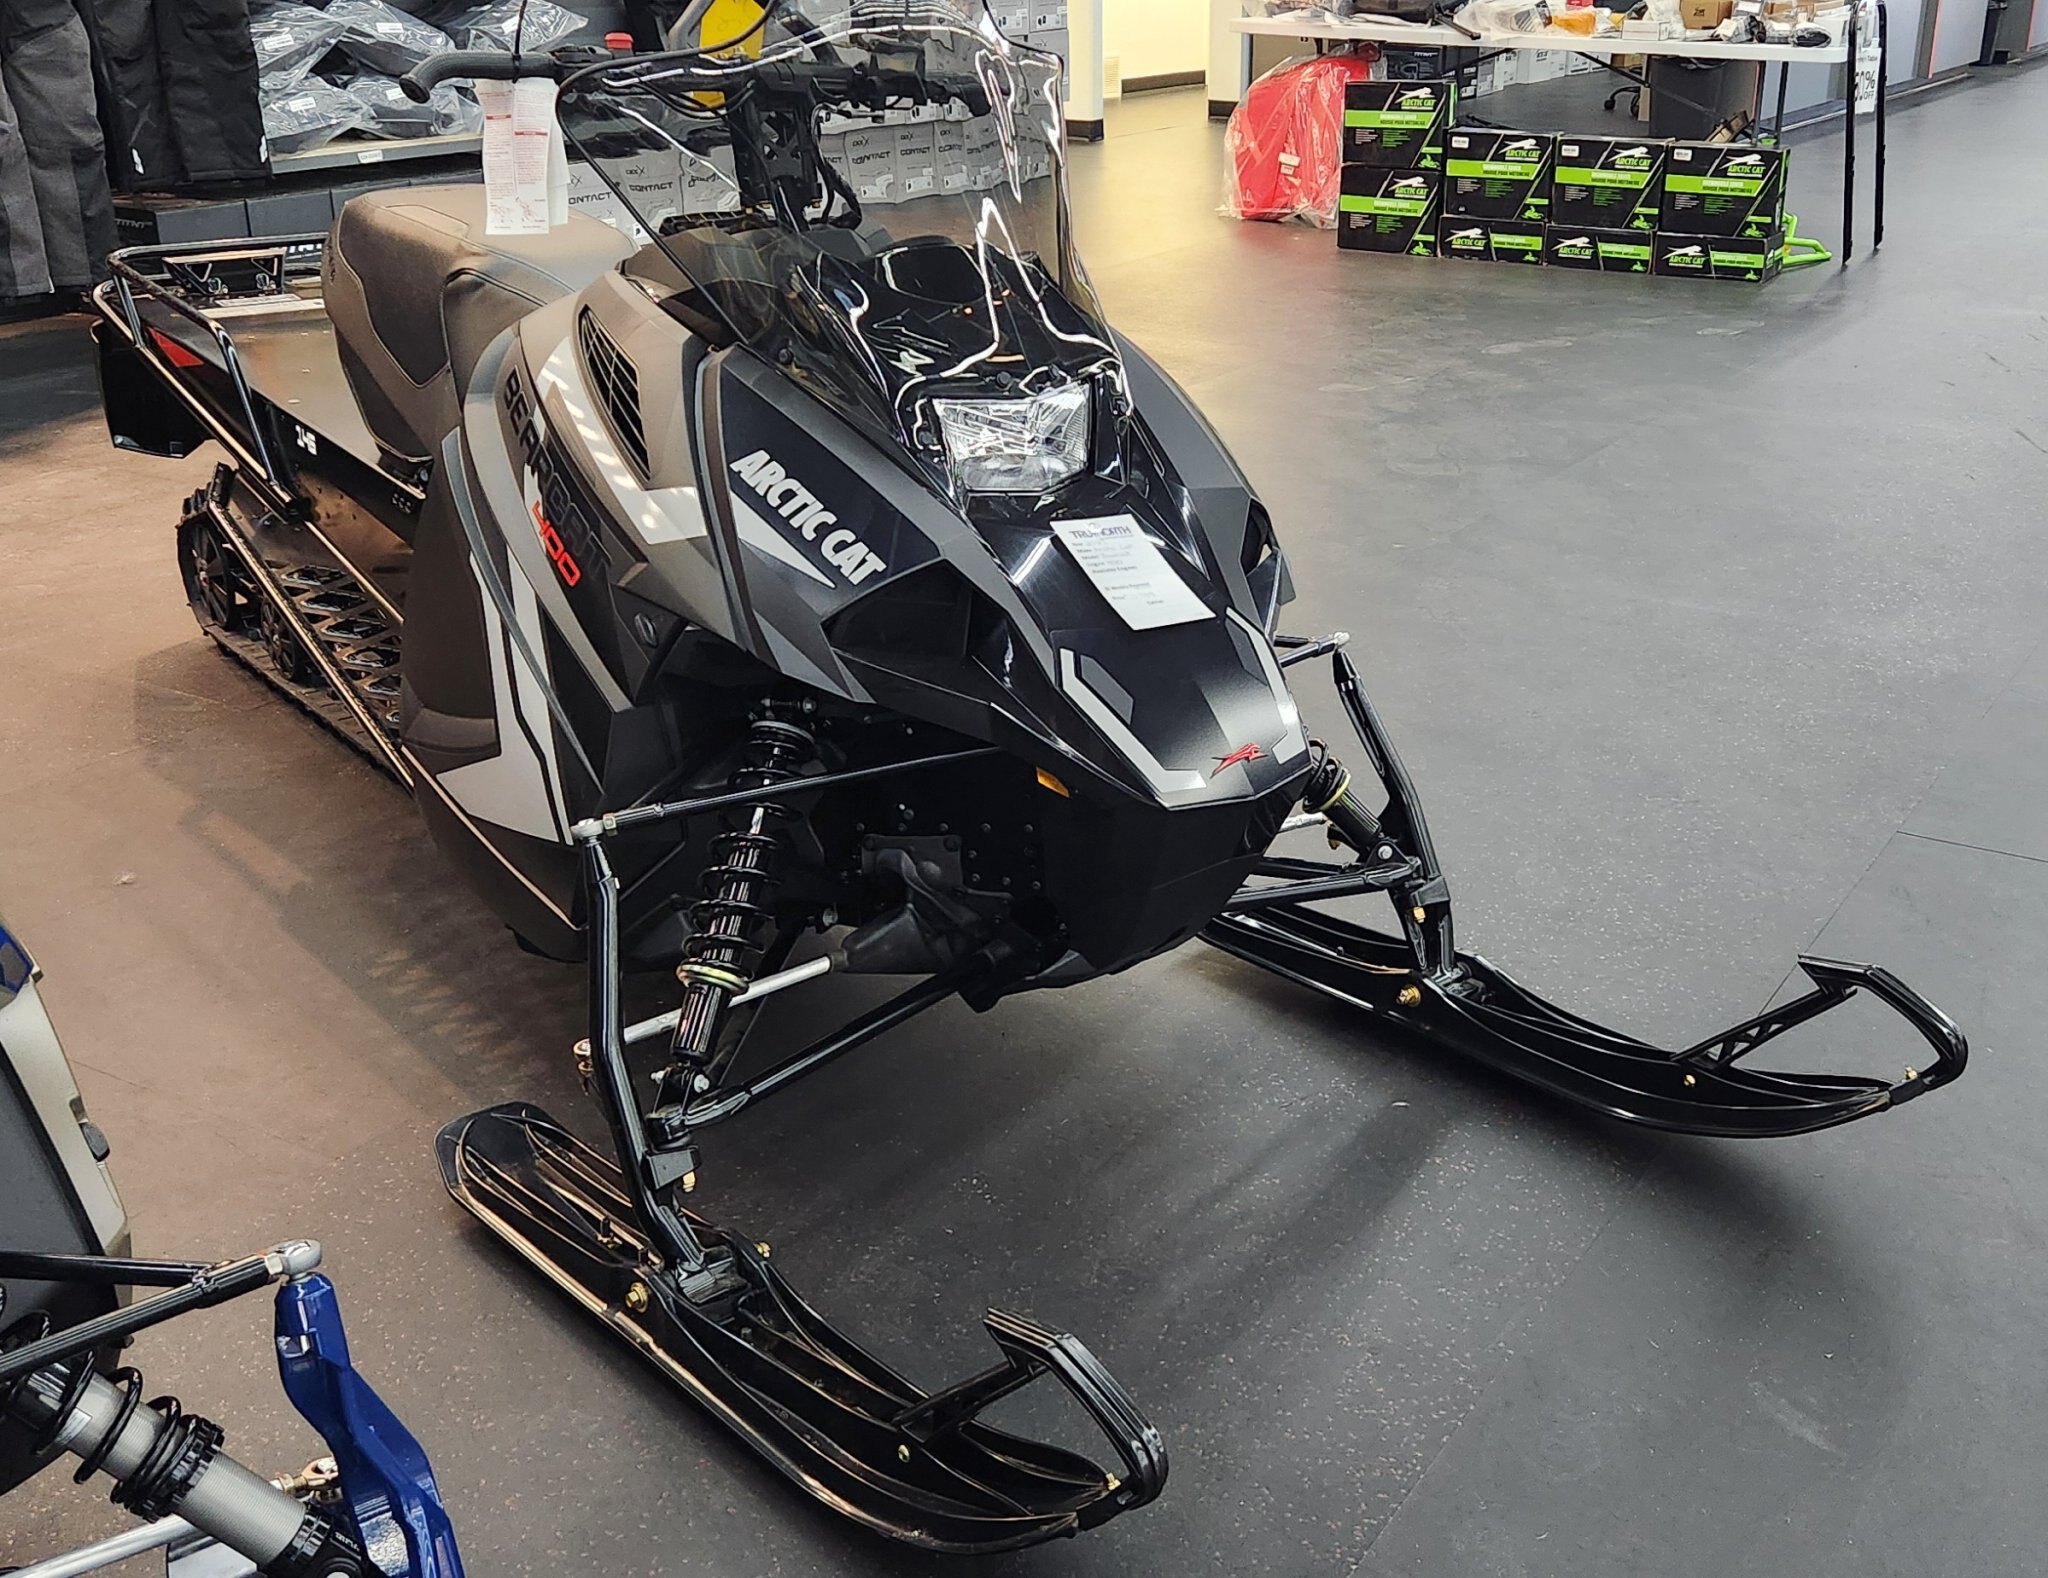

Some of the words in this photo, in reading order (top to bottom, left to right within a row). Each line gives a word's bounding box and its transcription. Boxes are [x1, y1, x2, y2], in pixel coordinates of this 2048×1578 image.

[1864, 91, 1875, 100] OFF
[1423, 99, 1437, 107] CAT
[1505, 149, 1527, 157] ARCTIC
[1527, 150, 1541, 158] CAT
[1615, 158, 1638, 166] ARCTIC
[1638, 159, 1653, 167] CAT
[1727, 165, 1751, 173] ARCTIC
[1751, 166, 1766, 174] CAT
[628, 181, 674, 194] CONTACT
[1416, 188, 1430, 196] CAT
[568, 191, 612, 205] ONTACT
[1451, 238, 1474, 246] ARCTIC
[1473, 239, 1488, 247] CAT
[1558, 246, 1581, 255] ARCTIC
[1580, 248, 1594, 256] CAT
[1669, 255, 1692, 263] ARCTIC
[1692, 256, 1709, 264] CAT
[503, 368, 614, 578] BEARCAT
[729, 449, 830, 541] ARCTIC
[820, 525, 888, 586] CAT
[532, 500, 583, 588] 400
